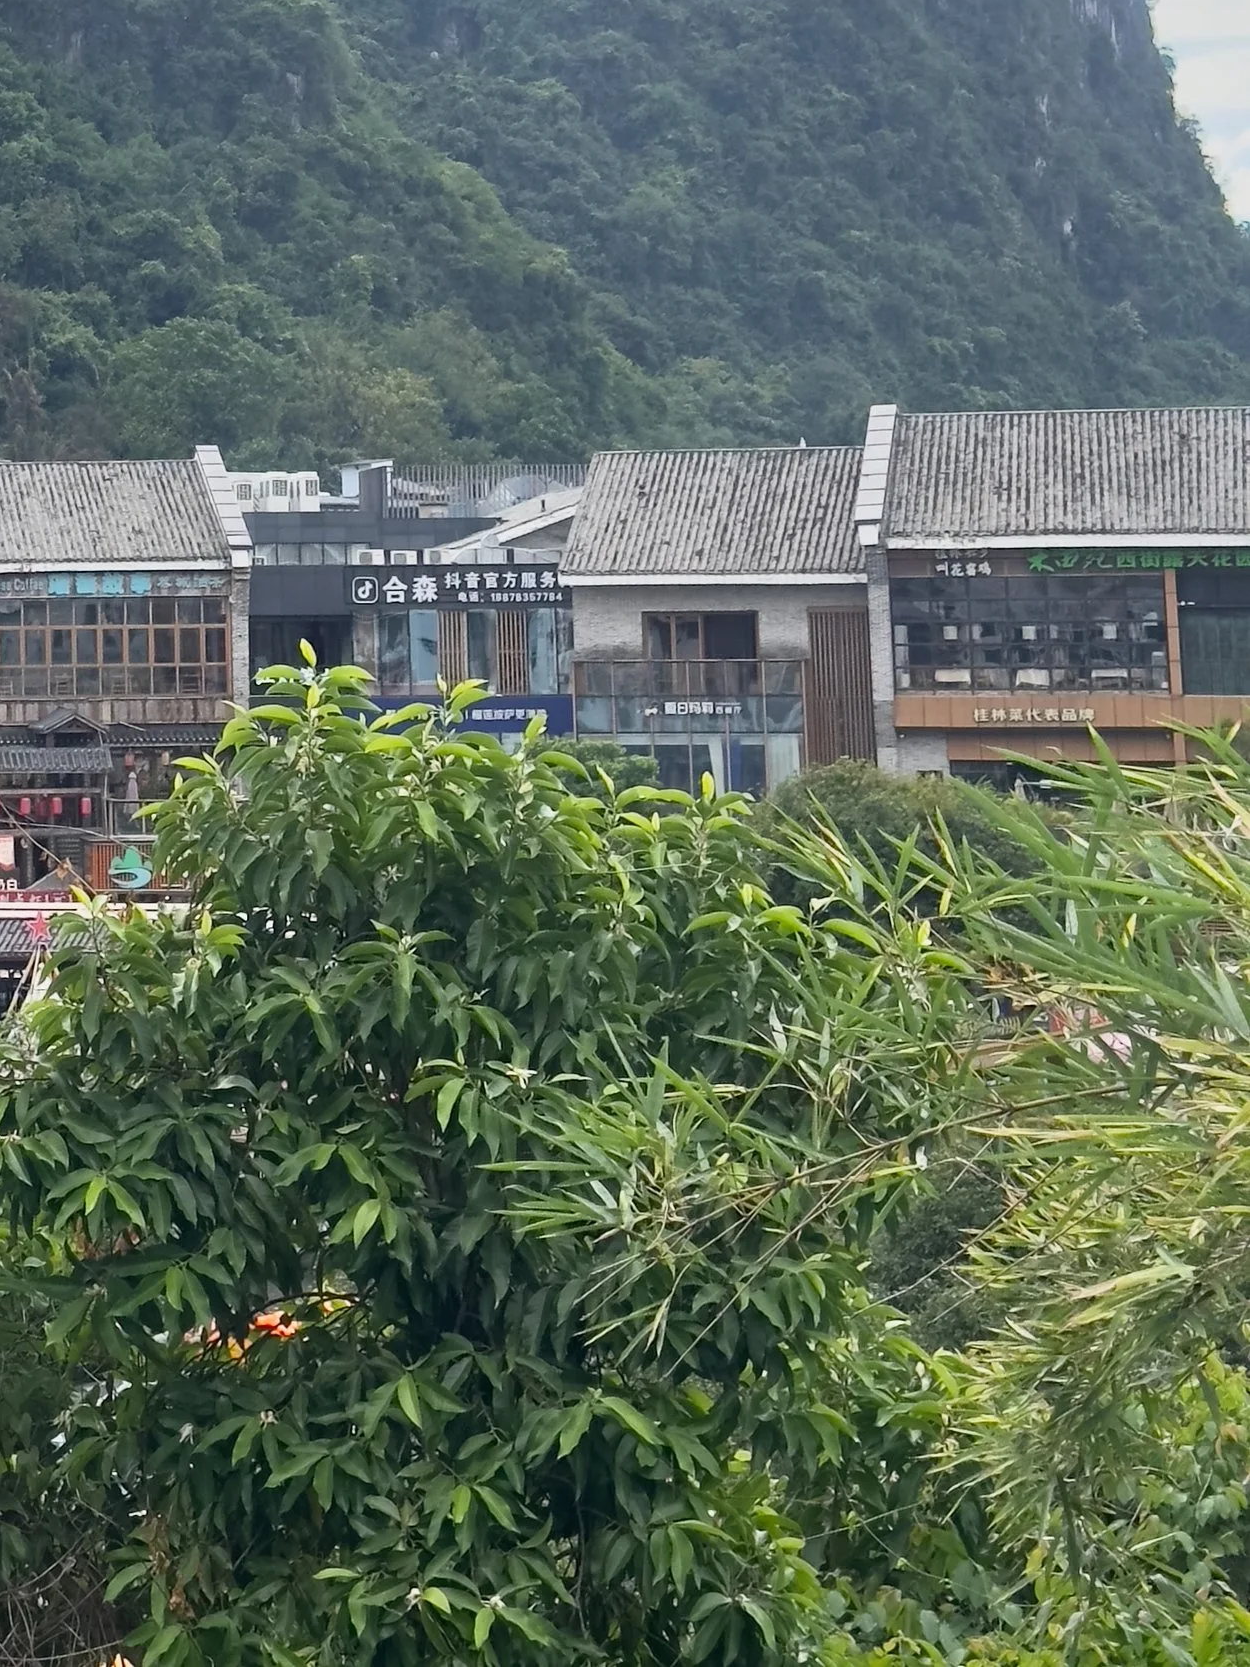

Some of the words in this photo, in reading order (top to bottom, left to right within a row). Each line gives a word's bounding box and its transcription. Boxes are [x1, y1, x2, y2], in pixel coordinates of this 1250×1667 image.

[382, 575, 438, 603] 合森
[445, 571, 572, 590] 抖音官方服务
[973, 708, 1095, 722] 桂林菜代表品牌
